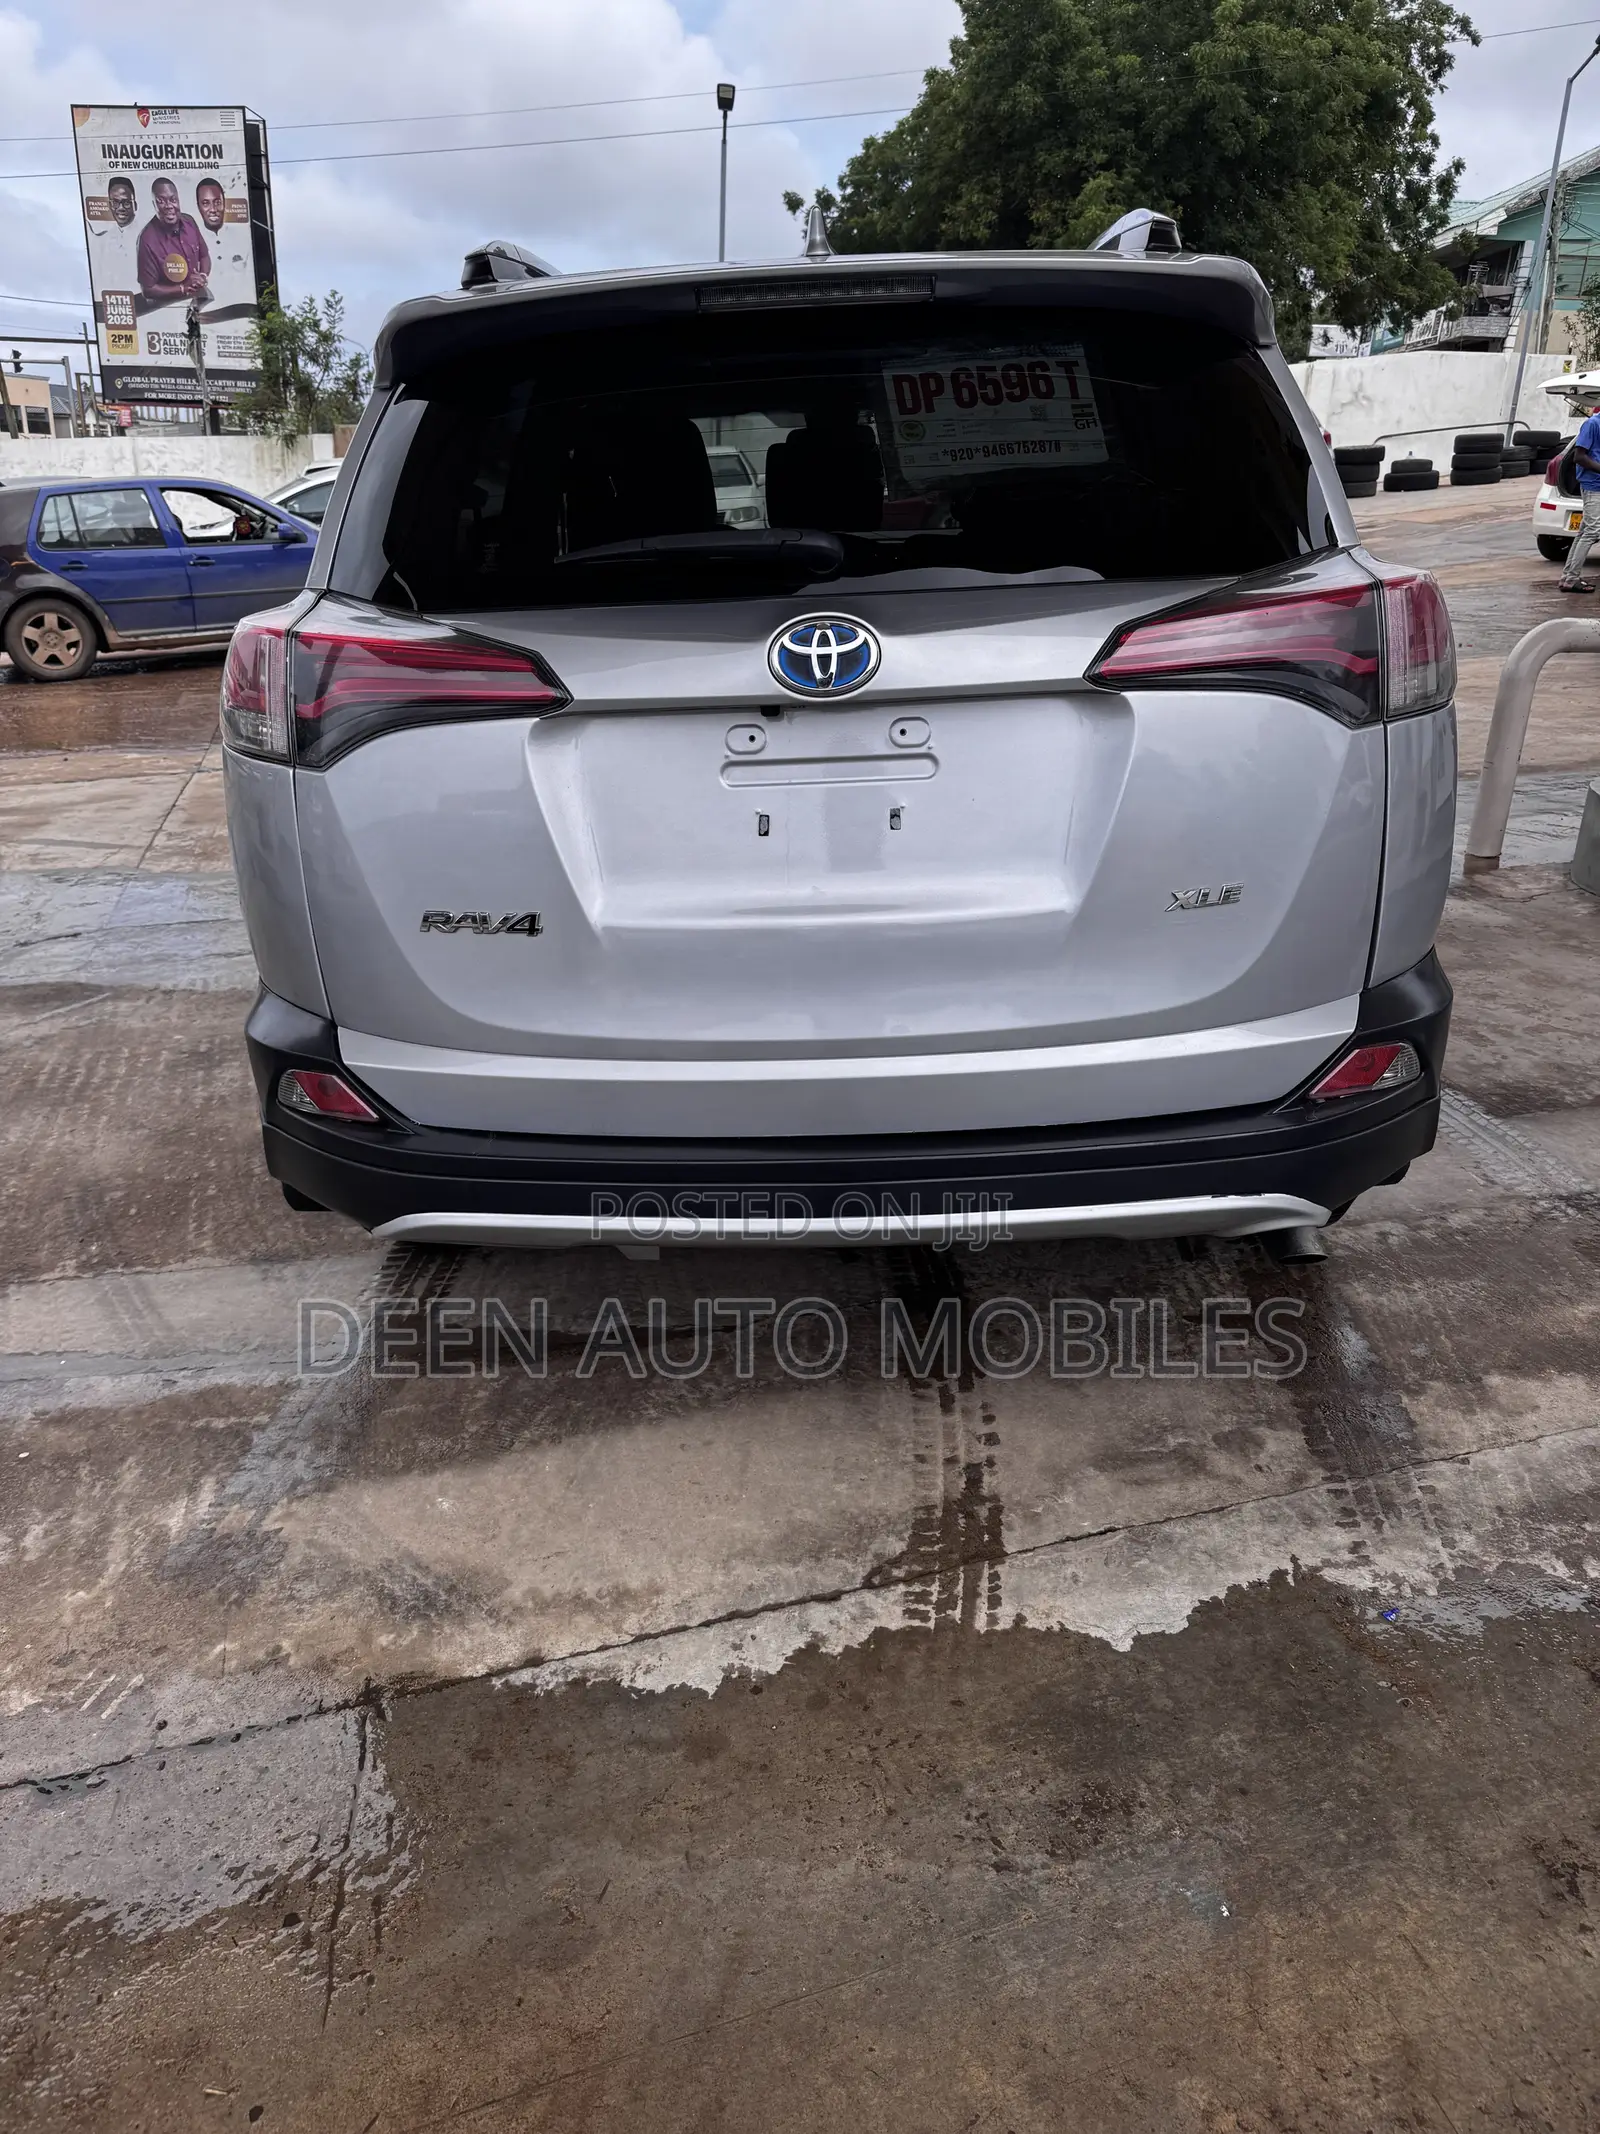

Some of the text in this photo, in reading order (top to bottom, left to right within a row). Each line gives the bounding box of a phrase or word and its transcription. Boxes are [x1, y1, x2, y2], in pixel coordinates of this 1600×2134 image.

[151, 109, 167, 117] EAGLE
[101, 143, 223, 160] INAUGURATION
[108, 160, 220, 170] OF NEW CHURCH BUILDING
[105, 295, 131, 305] 14TH
[106, 304, 133, 315] JUNE
[107, 314, 134, 325] 2026
[111, 333, 134, 344] 2PM
[148, 333, 161, 353] 3
[162, 338, 179, 347] ALL
[163, 346, 206, 357] SERVIS
[236, 380, 256, 388] HILLS
[892, 360, 1080, 416] DP 6596 T
[144, 391, 157, 399] FOR
[158, 392, 177, 400] MORE
[1074, 418, 1099, 431] GH
[1164, 882, 1244, 912] XLE
[420, 909, 543, 937] RAV4
